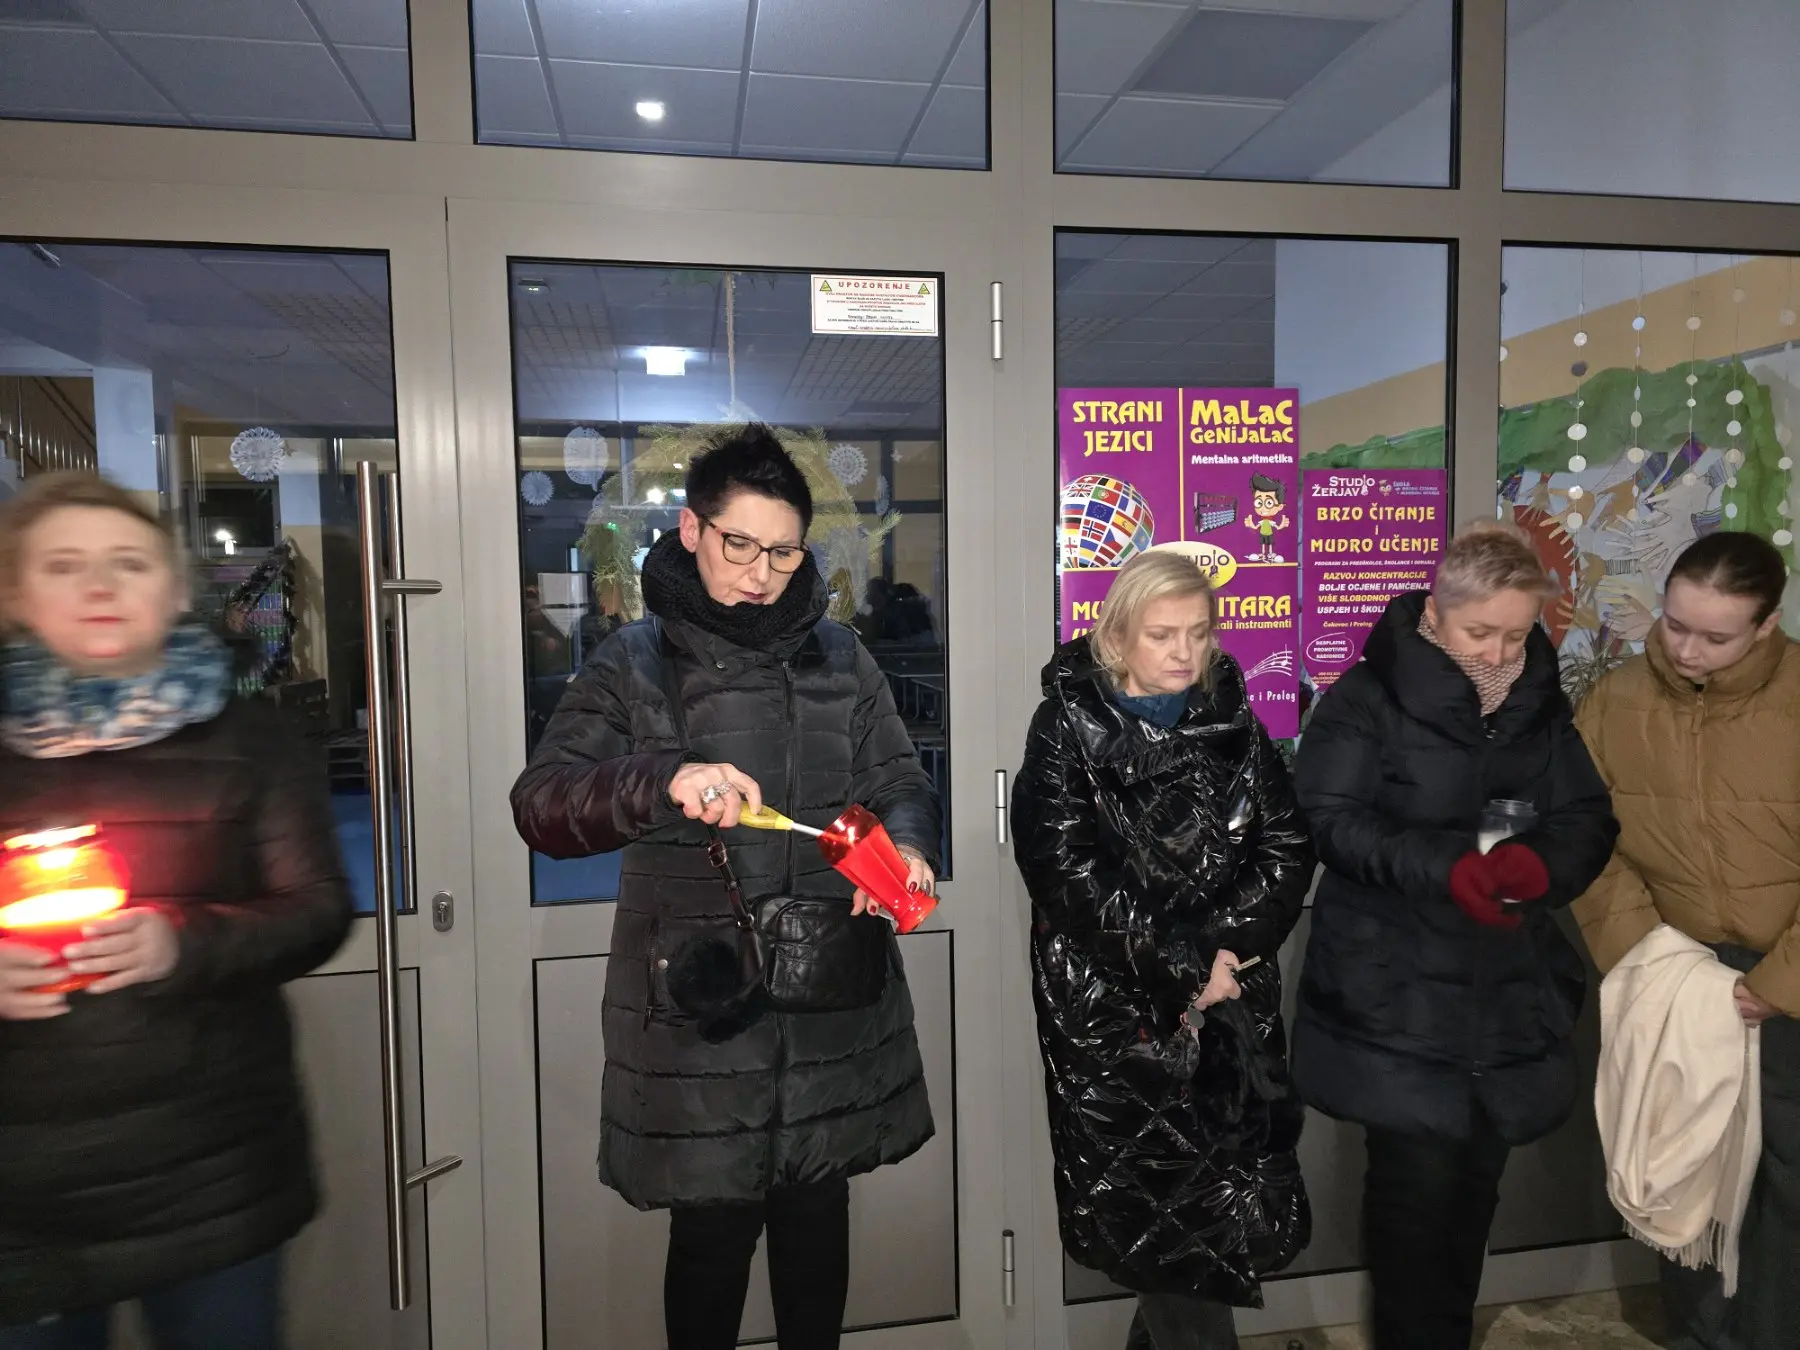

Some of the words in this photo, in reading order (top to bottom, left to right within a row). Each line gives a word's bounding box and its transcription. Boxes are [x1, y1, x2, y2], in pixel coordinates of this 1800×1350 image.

[838, 281, 911, 290] UPOZORENJE
[1072, 400, 1163, 425] STRANI
[1084, 430, 1153, 458] JEZICI
[1191, 454, 1239, 465] Mentalna
[1241, 453, 1294, 464] aritmetika
[1329, 475, 1376, 488] STUDIO
[1311, 483, 1360, 497] ŽERJAV
[1317, 507, 1364, 522] BRZO
[1369, 503, 1436, 523] ČITANJE
[1310, 538, 1374, 554] MUDRO
[1379, 534, 1440, 555] UČENJE
[1323, 572, 1356, 580] RAZVOJ
[1358, 571, 1428, 580] KONCENTRACIJE
[1318, 583, 1349, 592] BOLJE
[1350, 583, 1381, 591] OCJENE
[1387, 581, 1432, 591] PAMĆENJE
[1318, 593, 1338, 603] VIŠE
[1339, 594, 1390, 603] SLOBODNOG
[1218, 595, 1292, 618] ITARA
[1317, 605, 1351, 614] USPJEH
[1352, 605, 1359, 614] U
[1235, 619, 1292, 630] instrumenti
